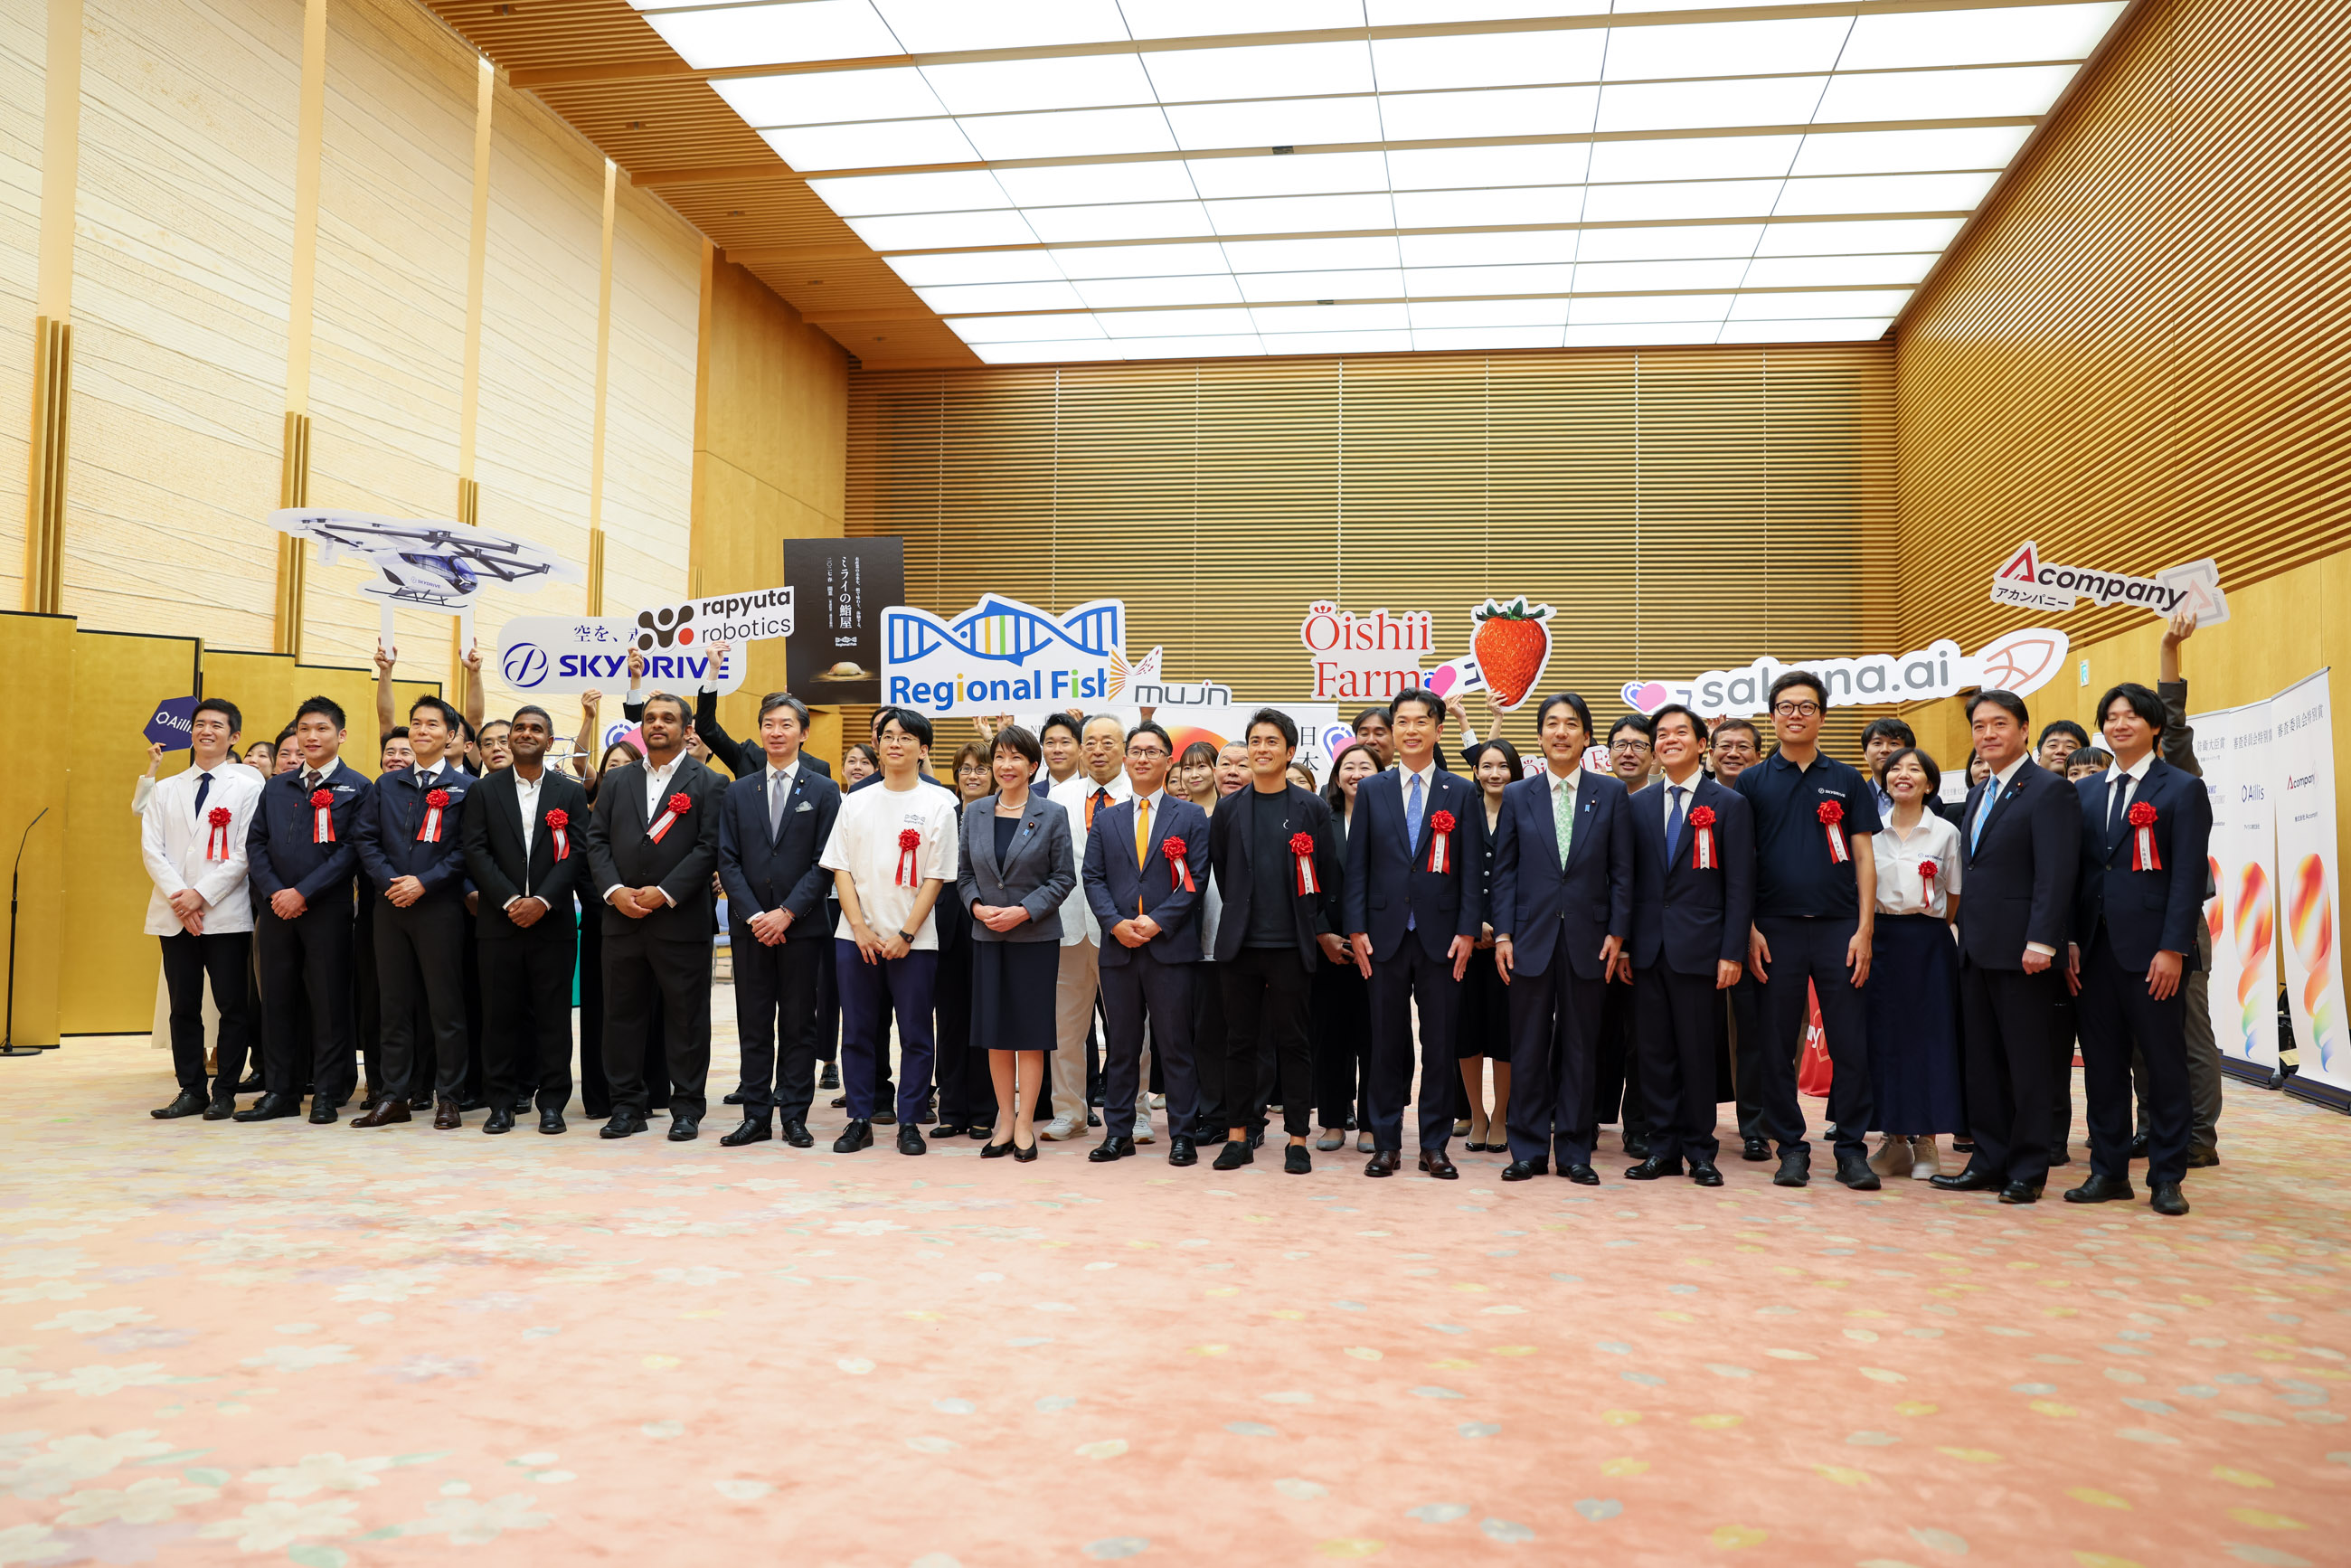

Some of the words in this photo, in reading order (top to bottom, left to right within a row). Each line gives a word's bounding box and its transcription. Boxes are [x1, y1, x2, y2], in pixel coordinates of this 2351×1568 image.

[839, 556, 852, 628] ミライの鮨屋
[2000, 546, 2188, 611] Acompany
[703, 590, 790, 619] rapyuta
[1997, 587, 2069, 607] アカンパニー
[703, 618, 791, 643] robotics
[1306, 612, 1430, 651] Oishii
[890, 670, 1041, 711] Regional
[1317, 662, 1421, 697] Farm
[1701, 650, 1950, 708] sakna.ai
[166, 715, 192, 734] Ailli
[2248, 785, 2264, 801] Aillis
